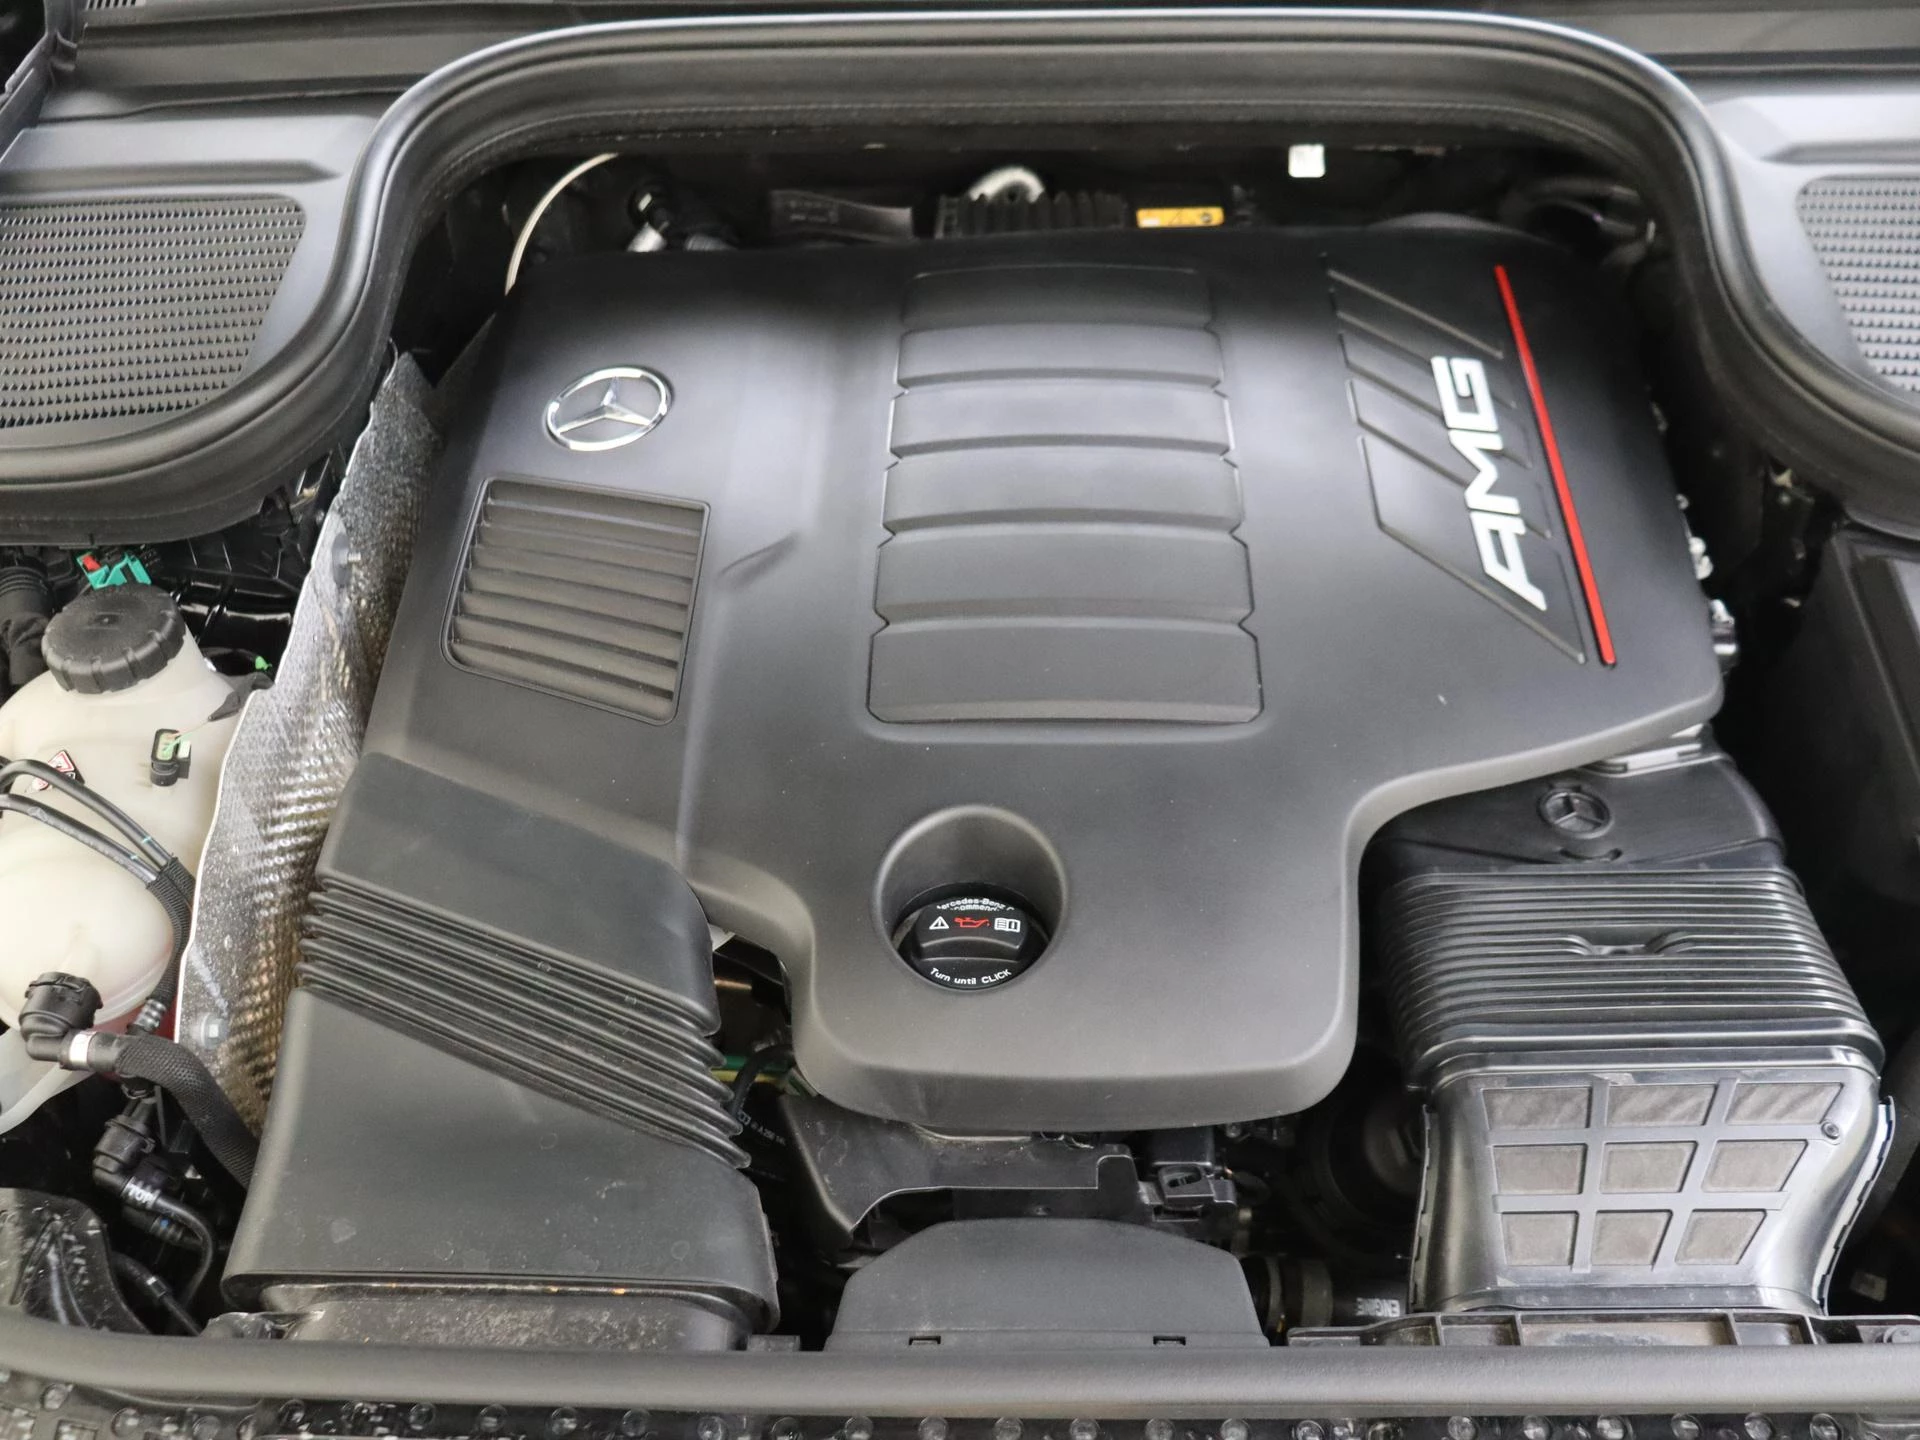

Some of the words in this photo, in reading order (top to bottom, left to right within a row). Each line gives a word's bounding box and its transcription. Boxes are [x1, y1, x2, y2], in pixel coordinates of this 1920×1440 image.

[1431, 356, 1547, 611] AMG
[930, 967, 951, 982] Turn
[954, 977, 977, 985] until
[981, 968, 1012, 984] CLICK
